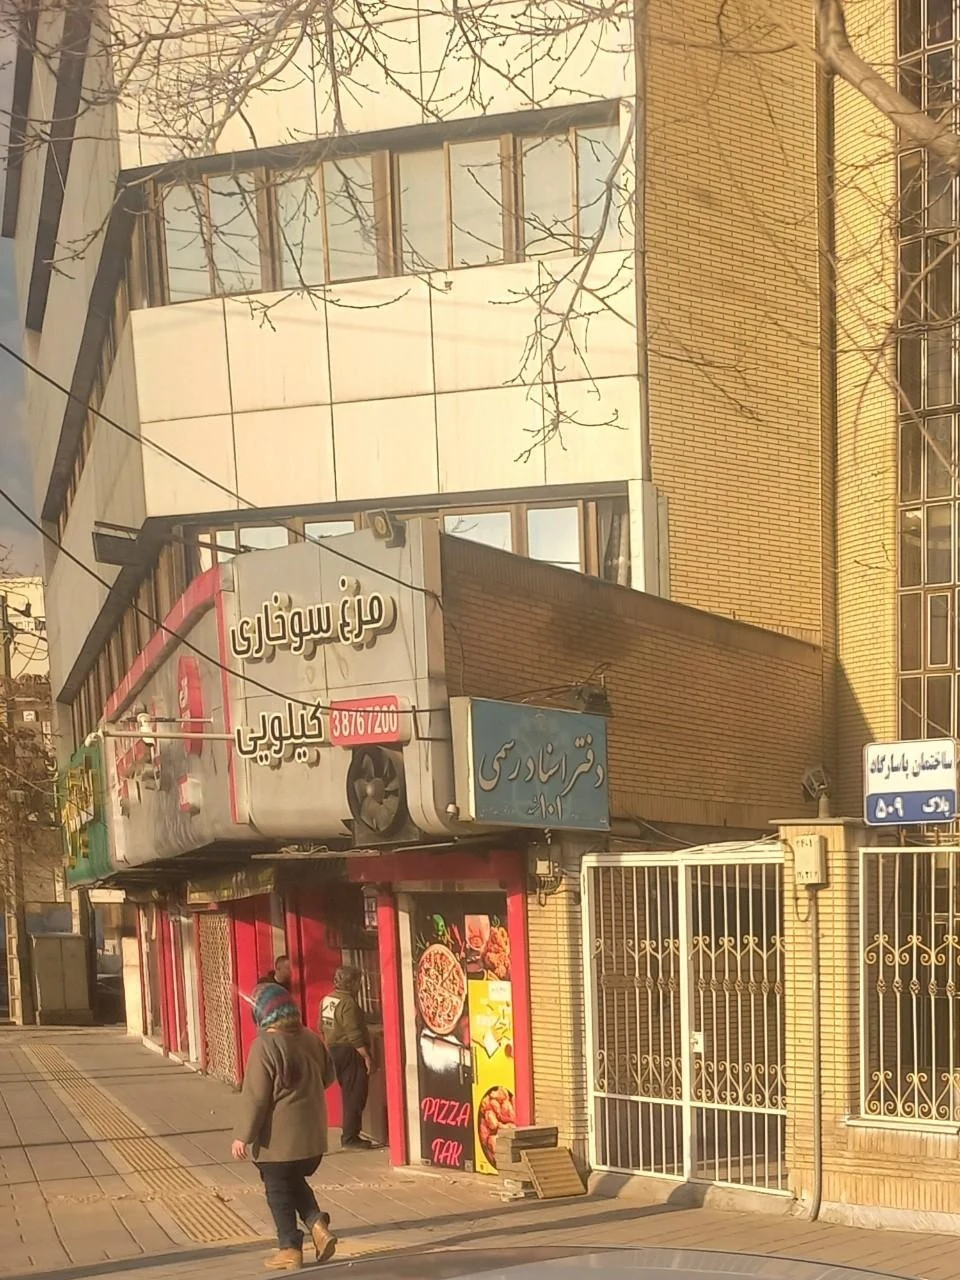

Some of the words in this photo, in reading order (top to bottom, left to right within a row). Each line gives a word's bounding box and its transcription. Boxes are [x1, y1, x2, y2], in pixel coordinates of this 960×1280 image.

[230, 591, 332, 659] سوخاری
[339, 575, 385, 643] مرغ
[235, 697, 324, 766] کیلویی
[332, 704, 398, 737] 38767200
[478, 738, 522, 792] رسمی
[524, 743, 567, 784] اسناد
[561, 733, 605, 797] دفتر
[911, 750, 953, 778] ساختمان
[540, 793, 562, 820] ۱۰۱
[875, 796, 904, 819] ۵۰۹
[921, 795, 950, 818] پلاک
[421, 1096, 471, 1128] PIZZA
[431, 1138, 463, 1167] TAK
